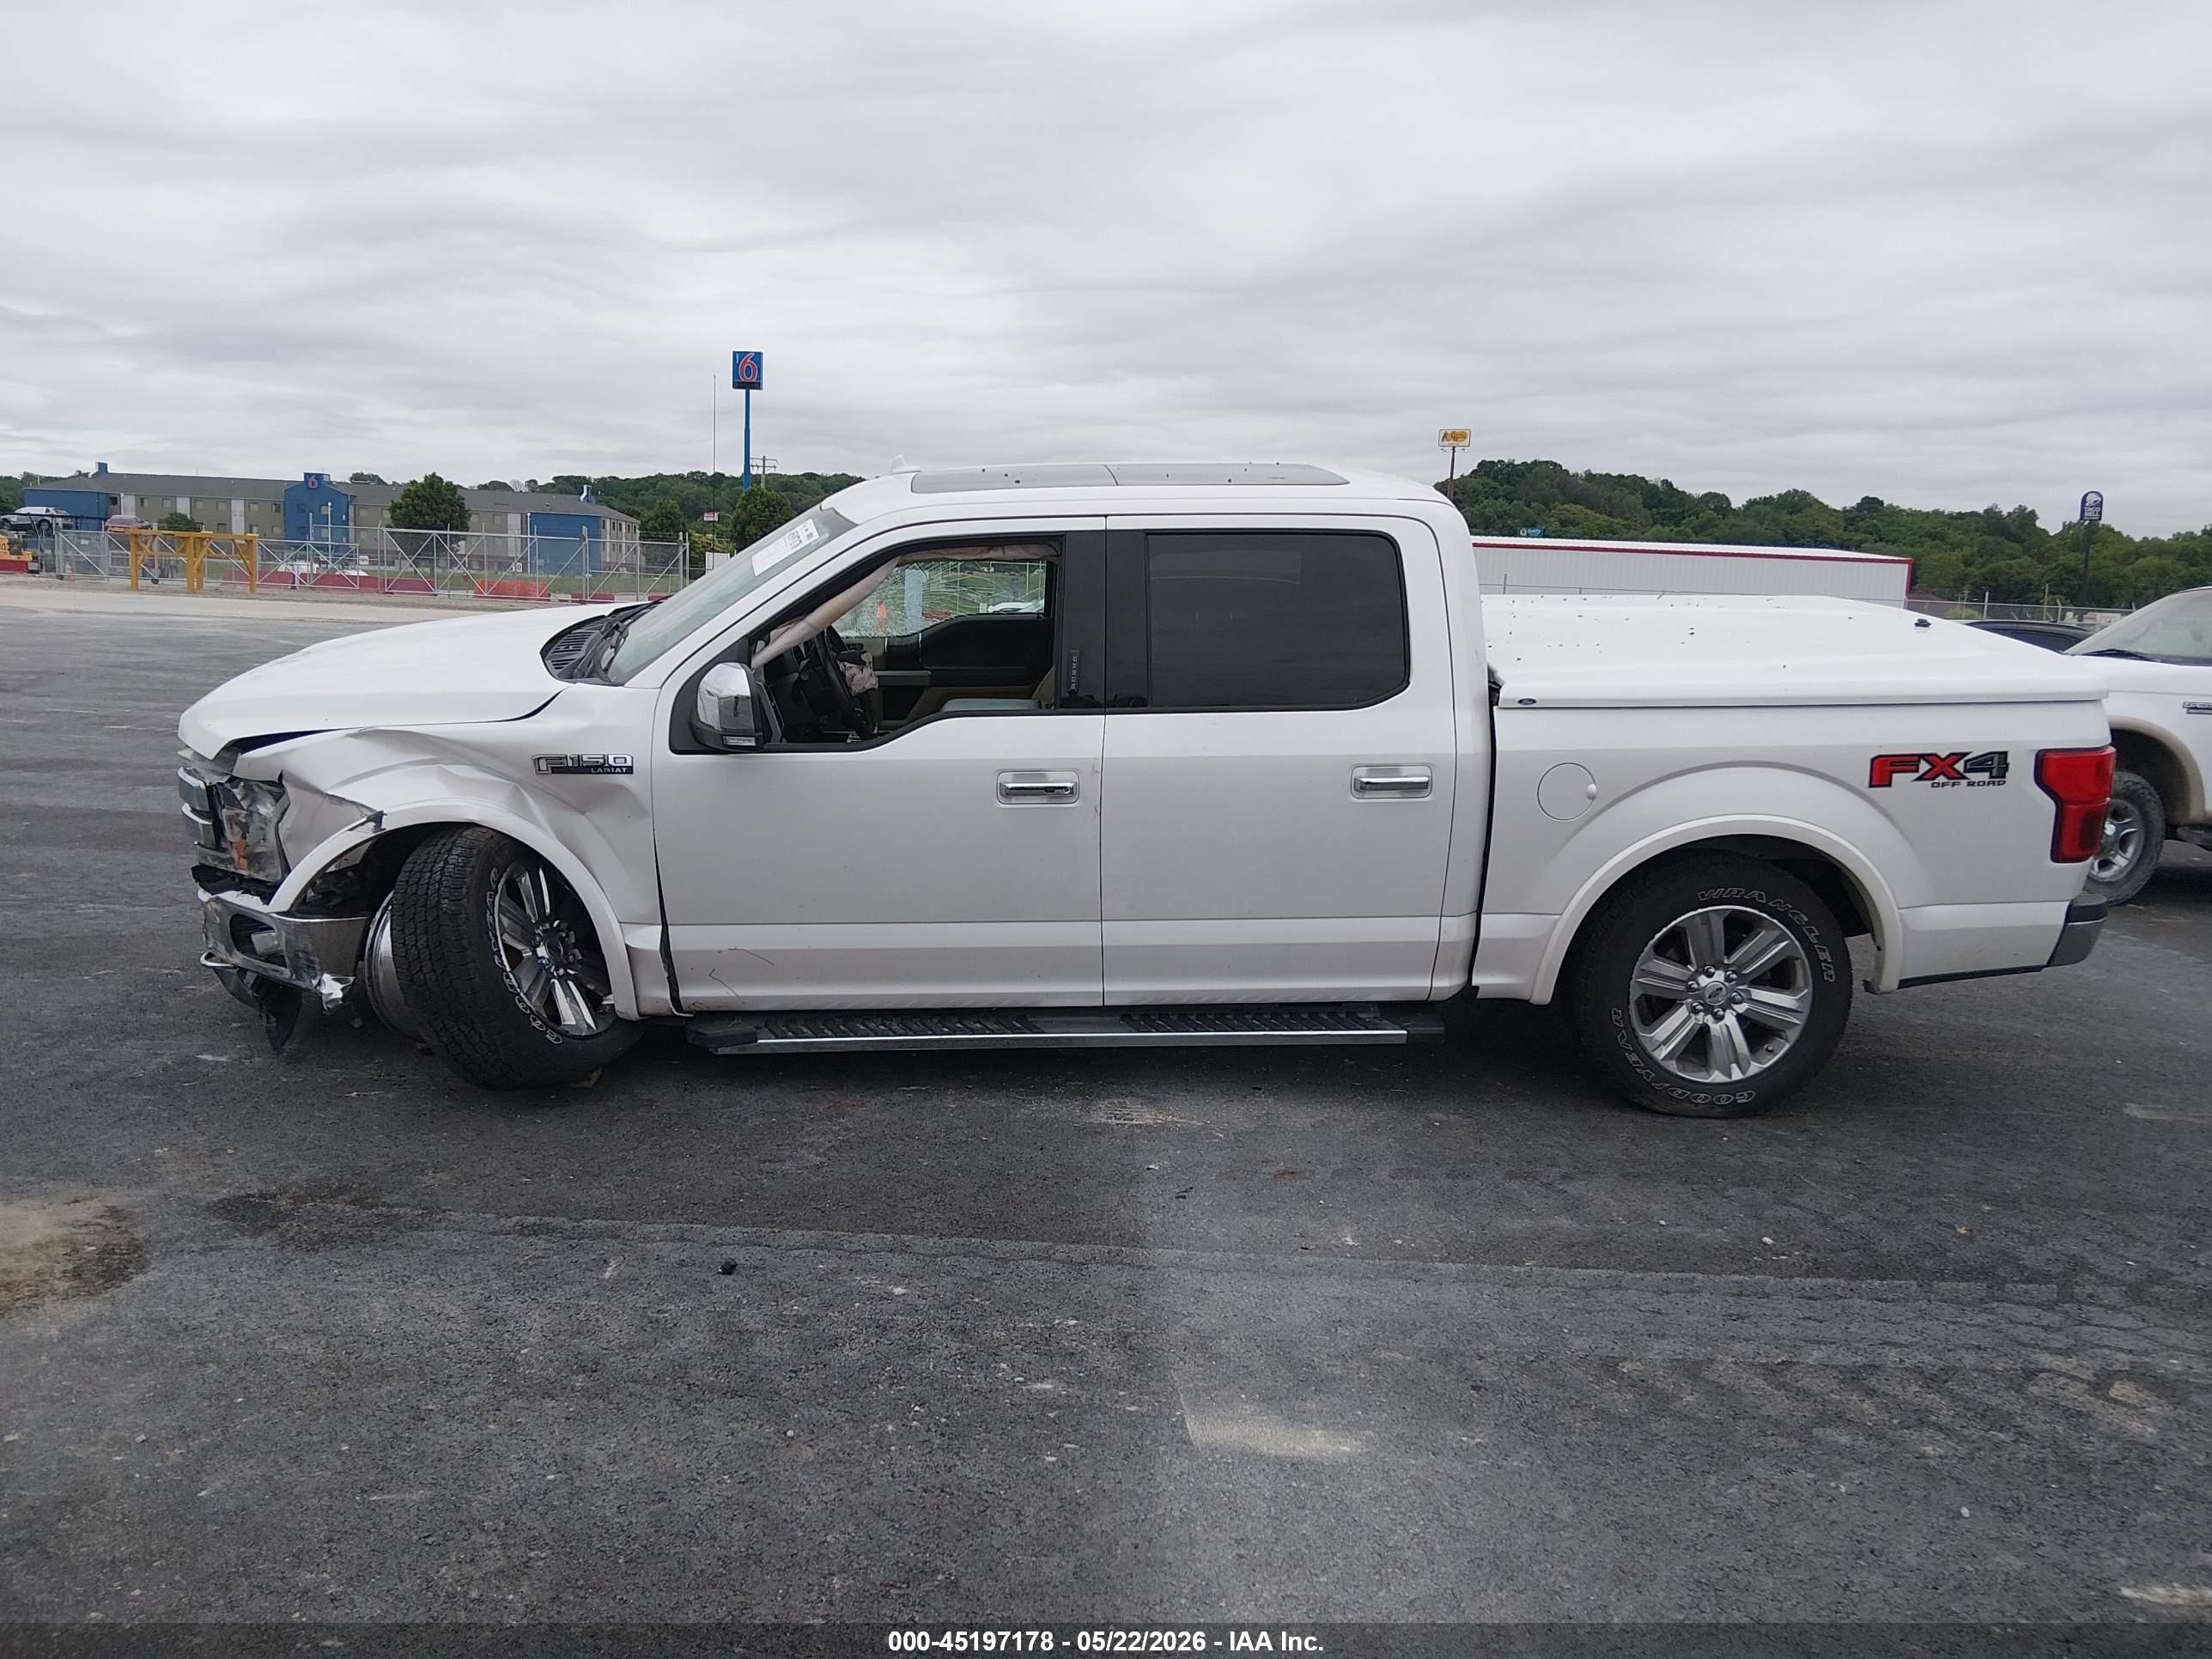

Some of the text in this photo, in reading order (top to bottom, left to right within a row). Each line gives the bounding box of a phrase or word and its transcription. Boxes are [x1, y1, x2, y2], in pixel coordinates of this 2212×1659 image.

[738, 352, 757, 382] 6
[307, 475, 318, 489] 6
[1869, 750, 2010, 788] FX4
[1697, 887, 1836, 982] WRANGLER
[1611, 1006, 1756, 1105] GOODYEAR
